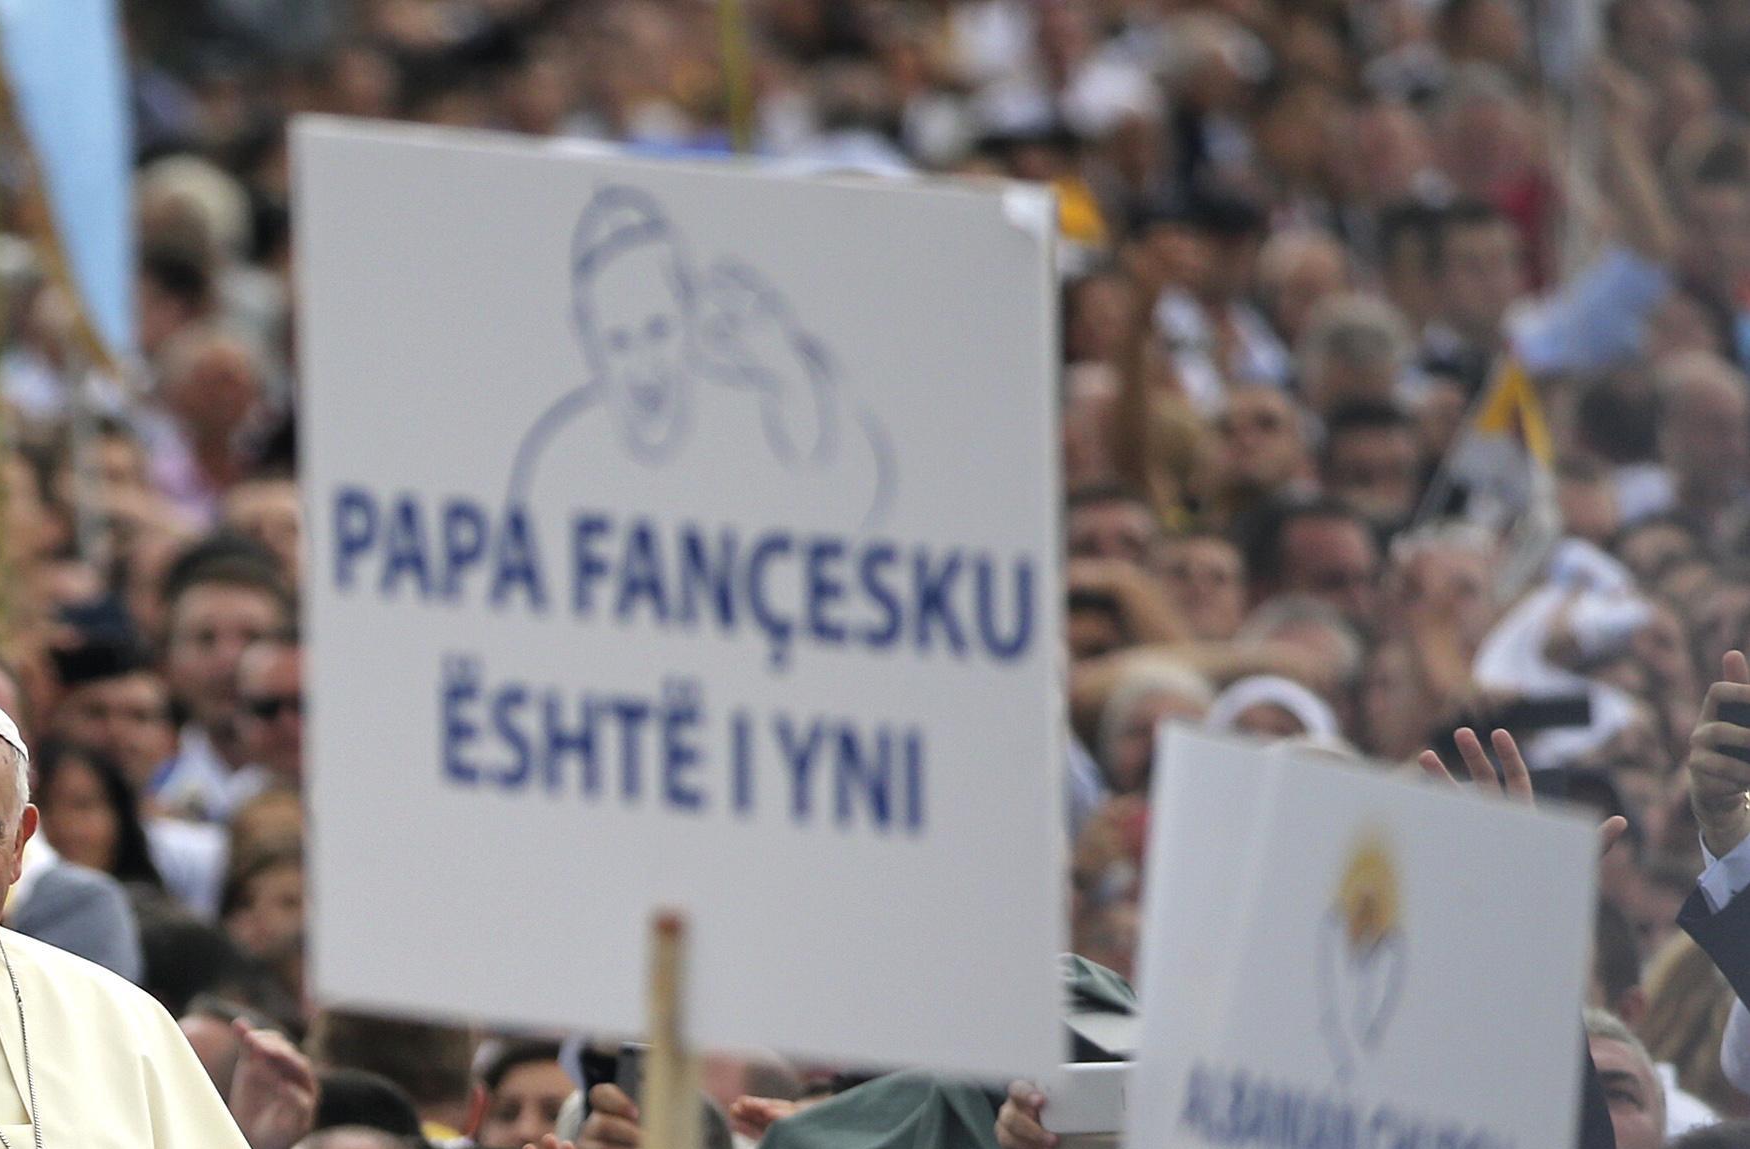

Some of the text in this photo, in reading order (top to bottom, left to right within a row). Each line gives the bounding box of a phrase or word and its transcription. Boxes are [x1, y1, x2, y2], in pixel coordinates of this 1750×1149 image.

[332, 487, 1037, 671] PAPA FANÇESKU
[440, 655, 925, 834] ËSHTË I YNI
